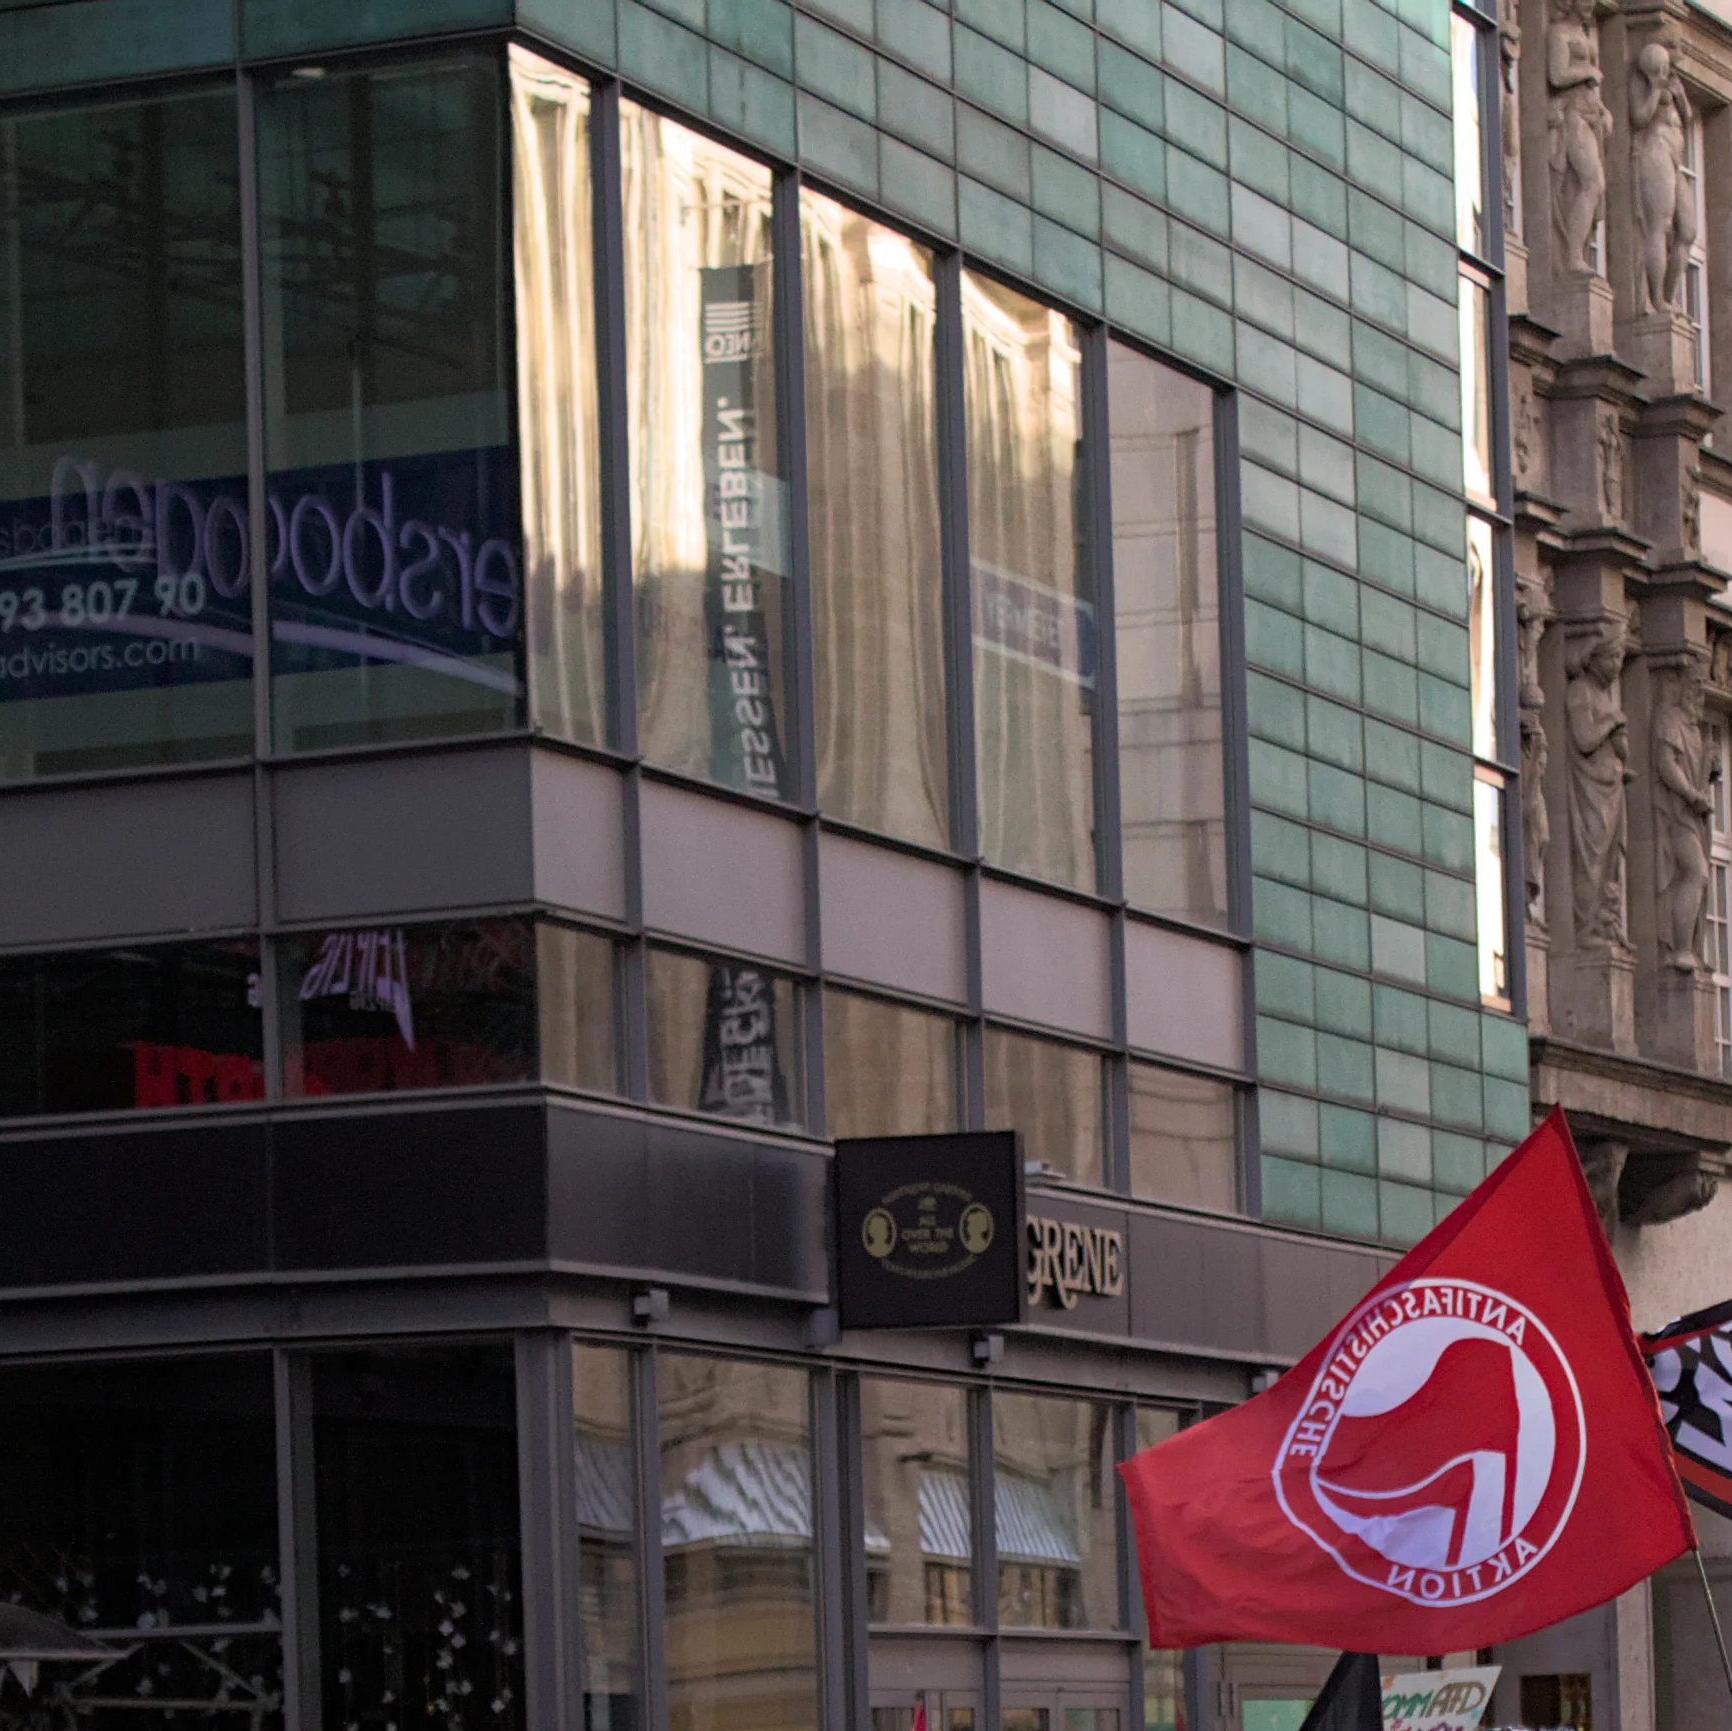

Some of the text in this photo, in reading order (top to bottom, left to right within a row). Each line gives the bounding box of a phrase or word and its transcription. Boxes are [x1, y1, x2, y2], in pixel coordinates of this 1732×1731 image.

[61, 578, 139, 627] 807
[153, 570, 206, 616] 90
[1027, 1215, 1124, 1310] GRENE
